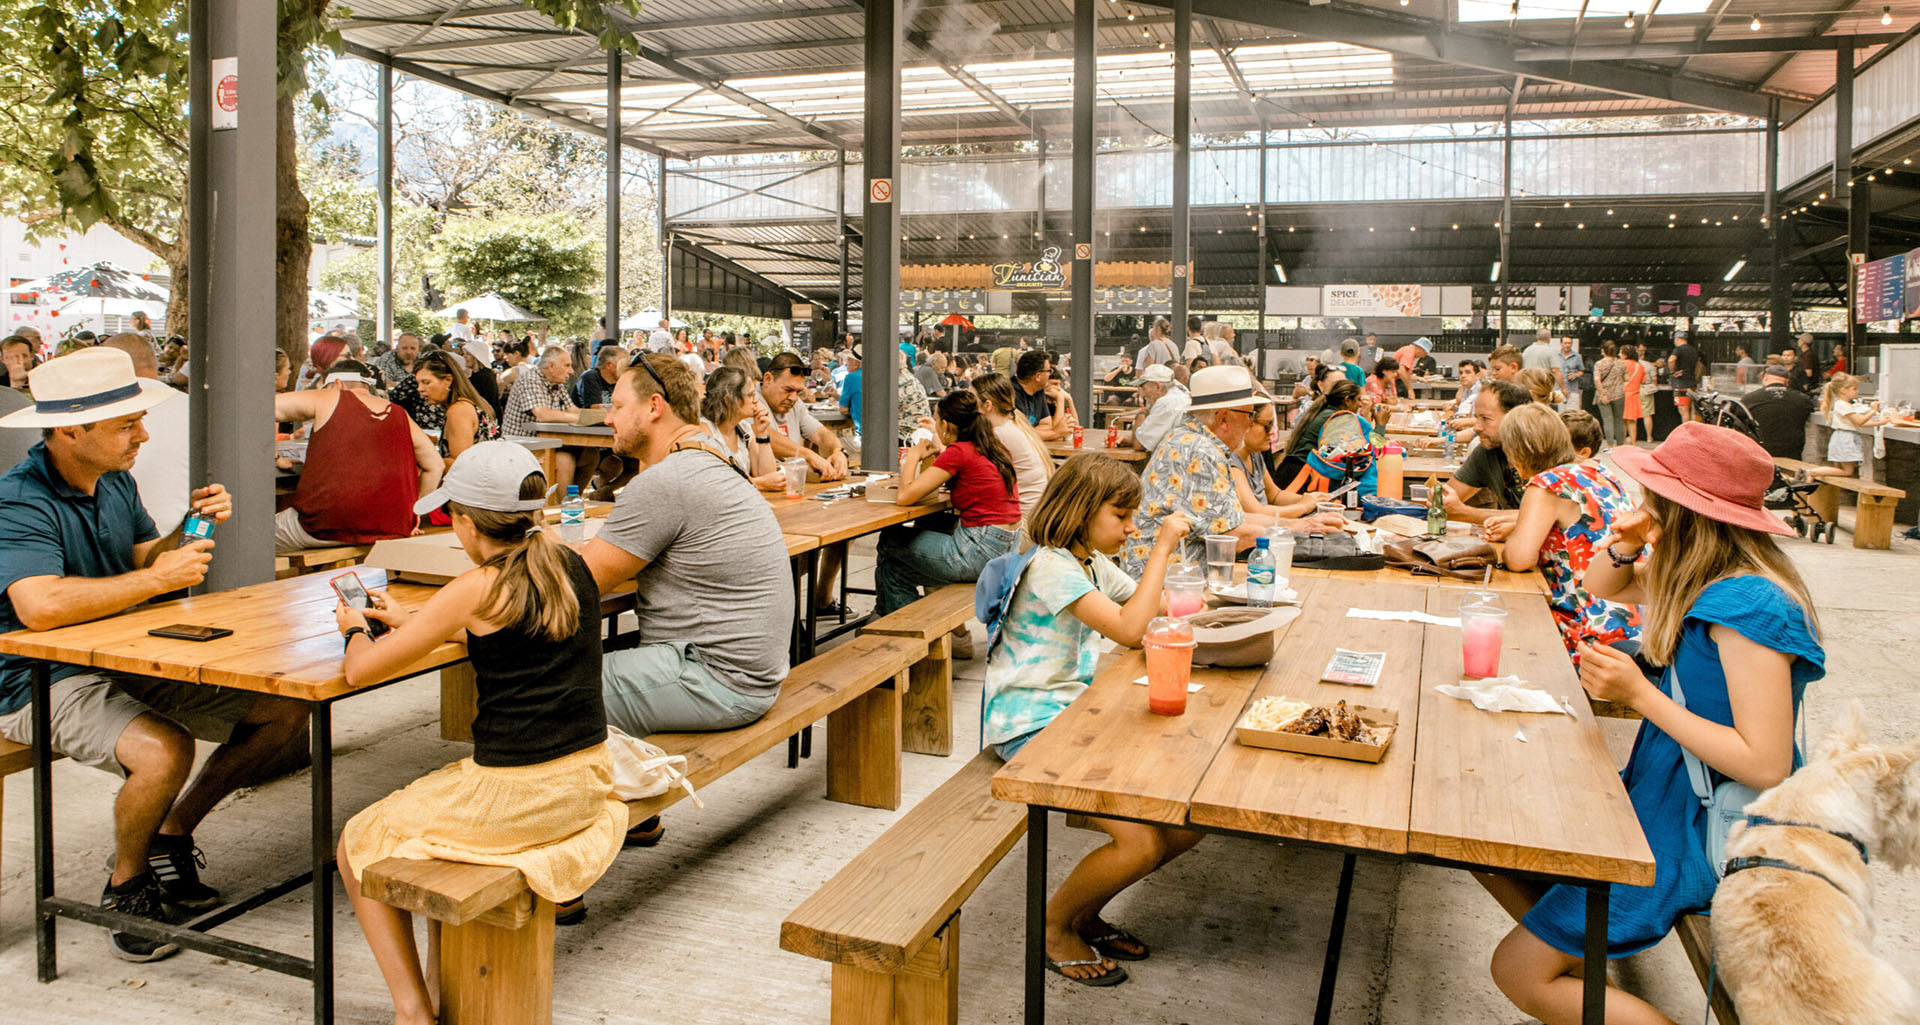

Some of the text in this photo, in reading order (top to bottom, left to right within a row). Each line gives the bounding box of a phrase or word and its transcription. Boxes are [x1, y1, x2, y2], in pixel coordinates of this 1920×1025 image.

[993, 263, 1063, 285] Tunisian
[1330, 290, 1359, 298] SPICE
[1856, 268, 1867, 320] MENU
